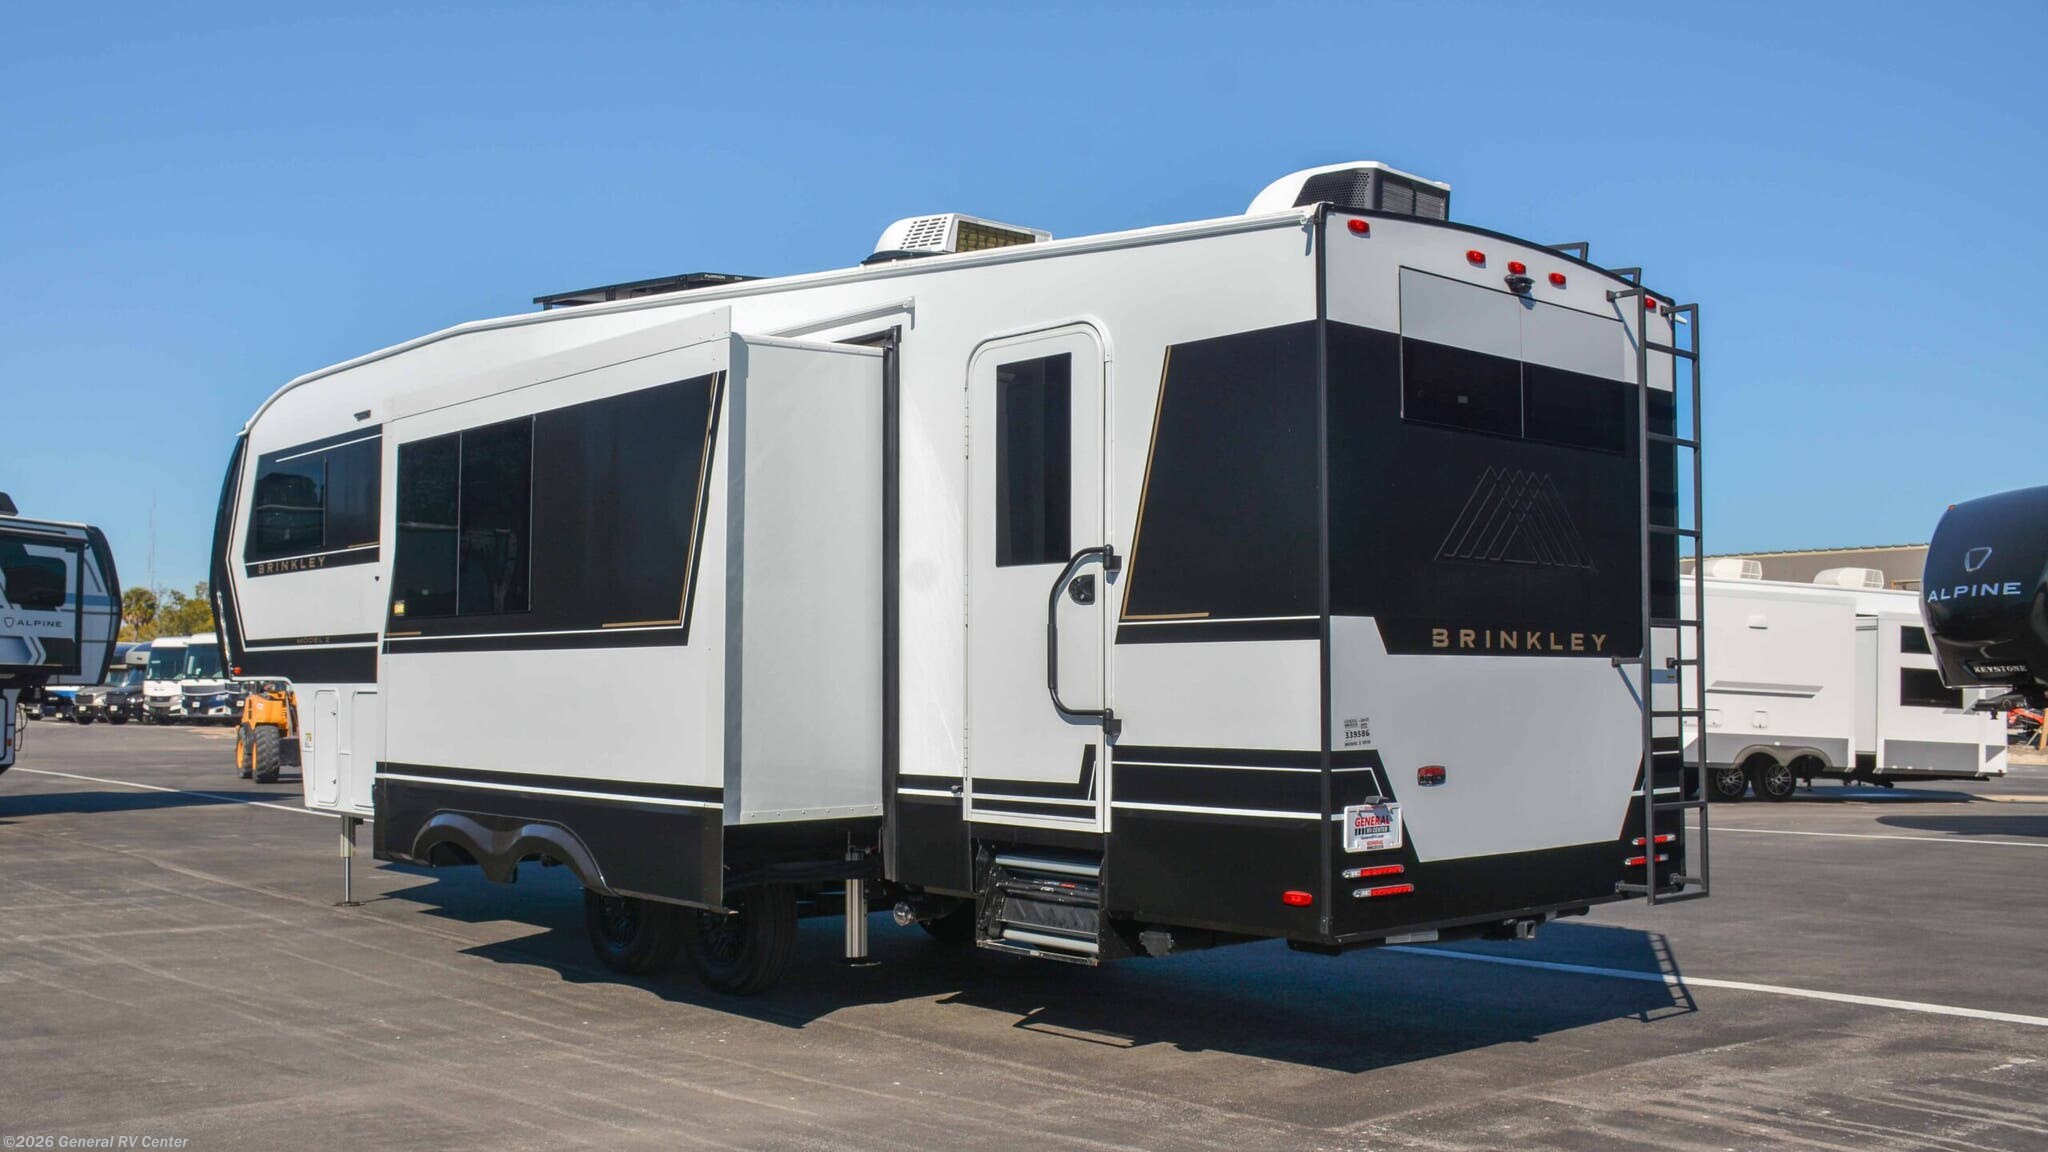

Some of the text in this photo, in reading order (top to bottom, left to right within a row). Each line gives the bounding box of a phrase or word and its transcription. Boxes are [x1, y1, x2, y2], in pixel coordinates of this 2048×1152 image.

[258, 556, 326, 575] BRINKLEY
[1927, 582, 2022, 603] ALPINE
[16, 619, 64, 628] ALPINE
[1432, 628, 1607, 651] BRINKLEY
[1973, 665, 2028, 673] KEYSTONE
[1345, 729, 1370, 739] 339586
[1354, 815, 1390, 827] GENERAL
